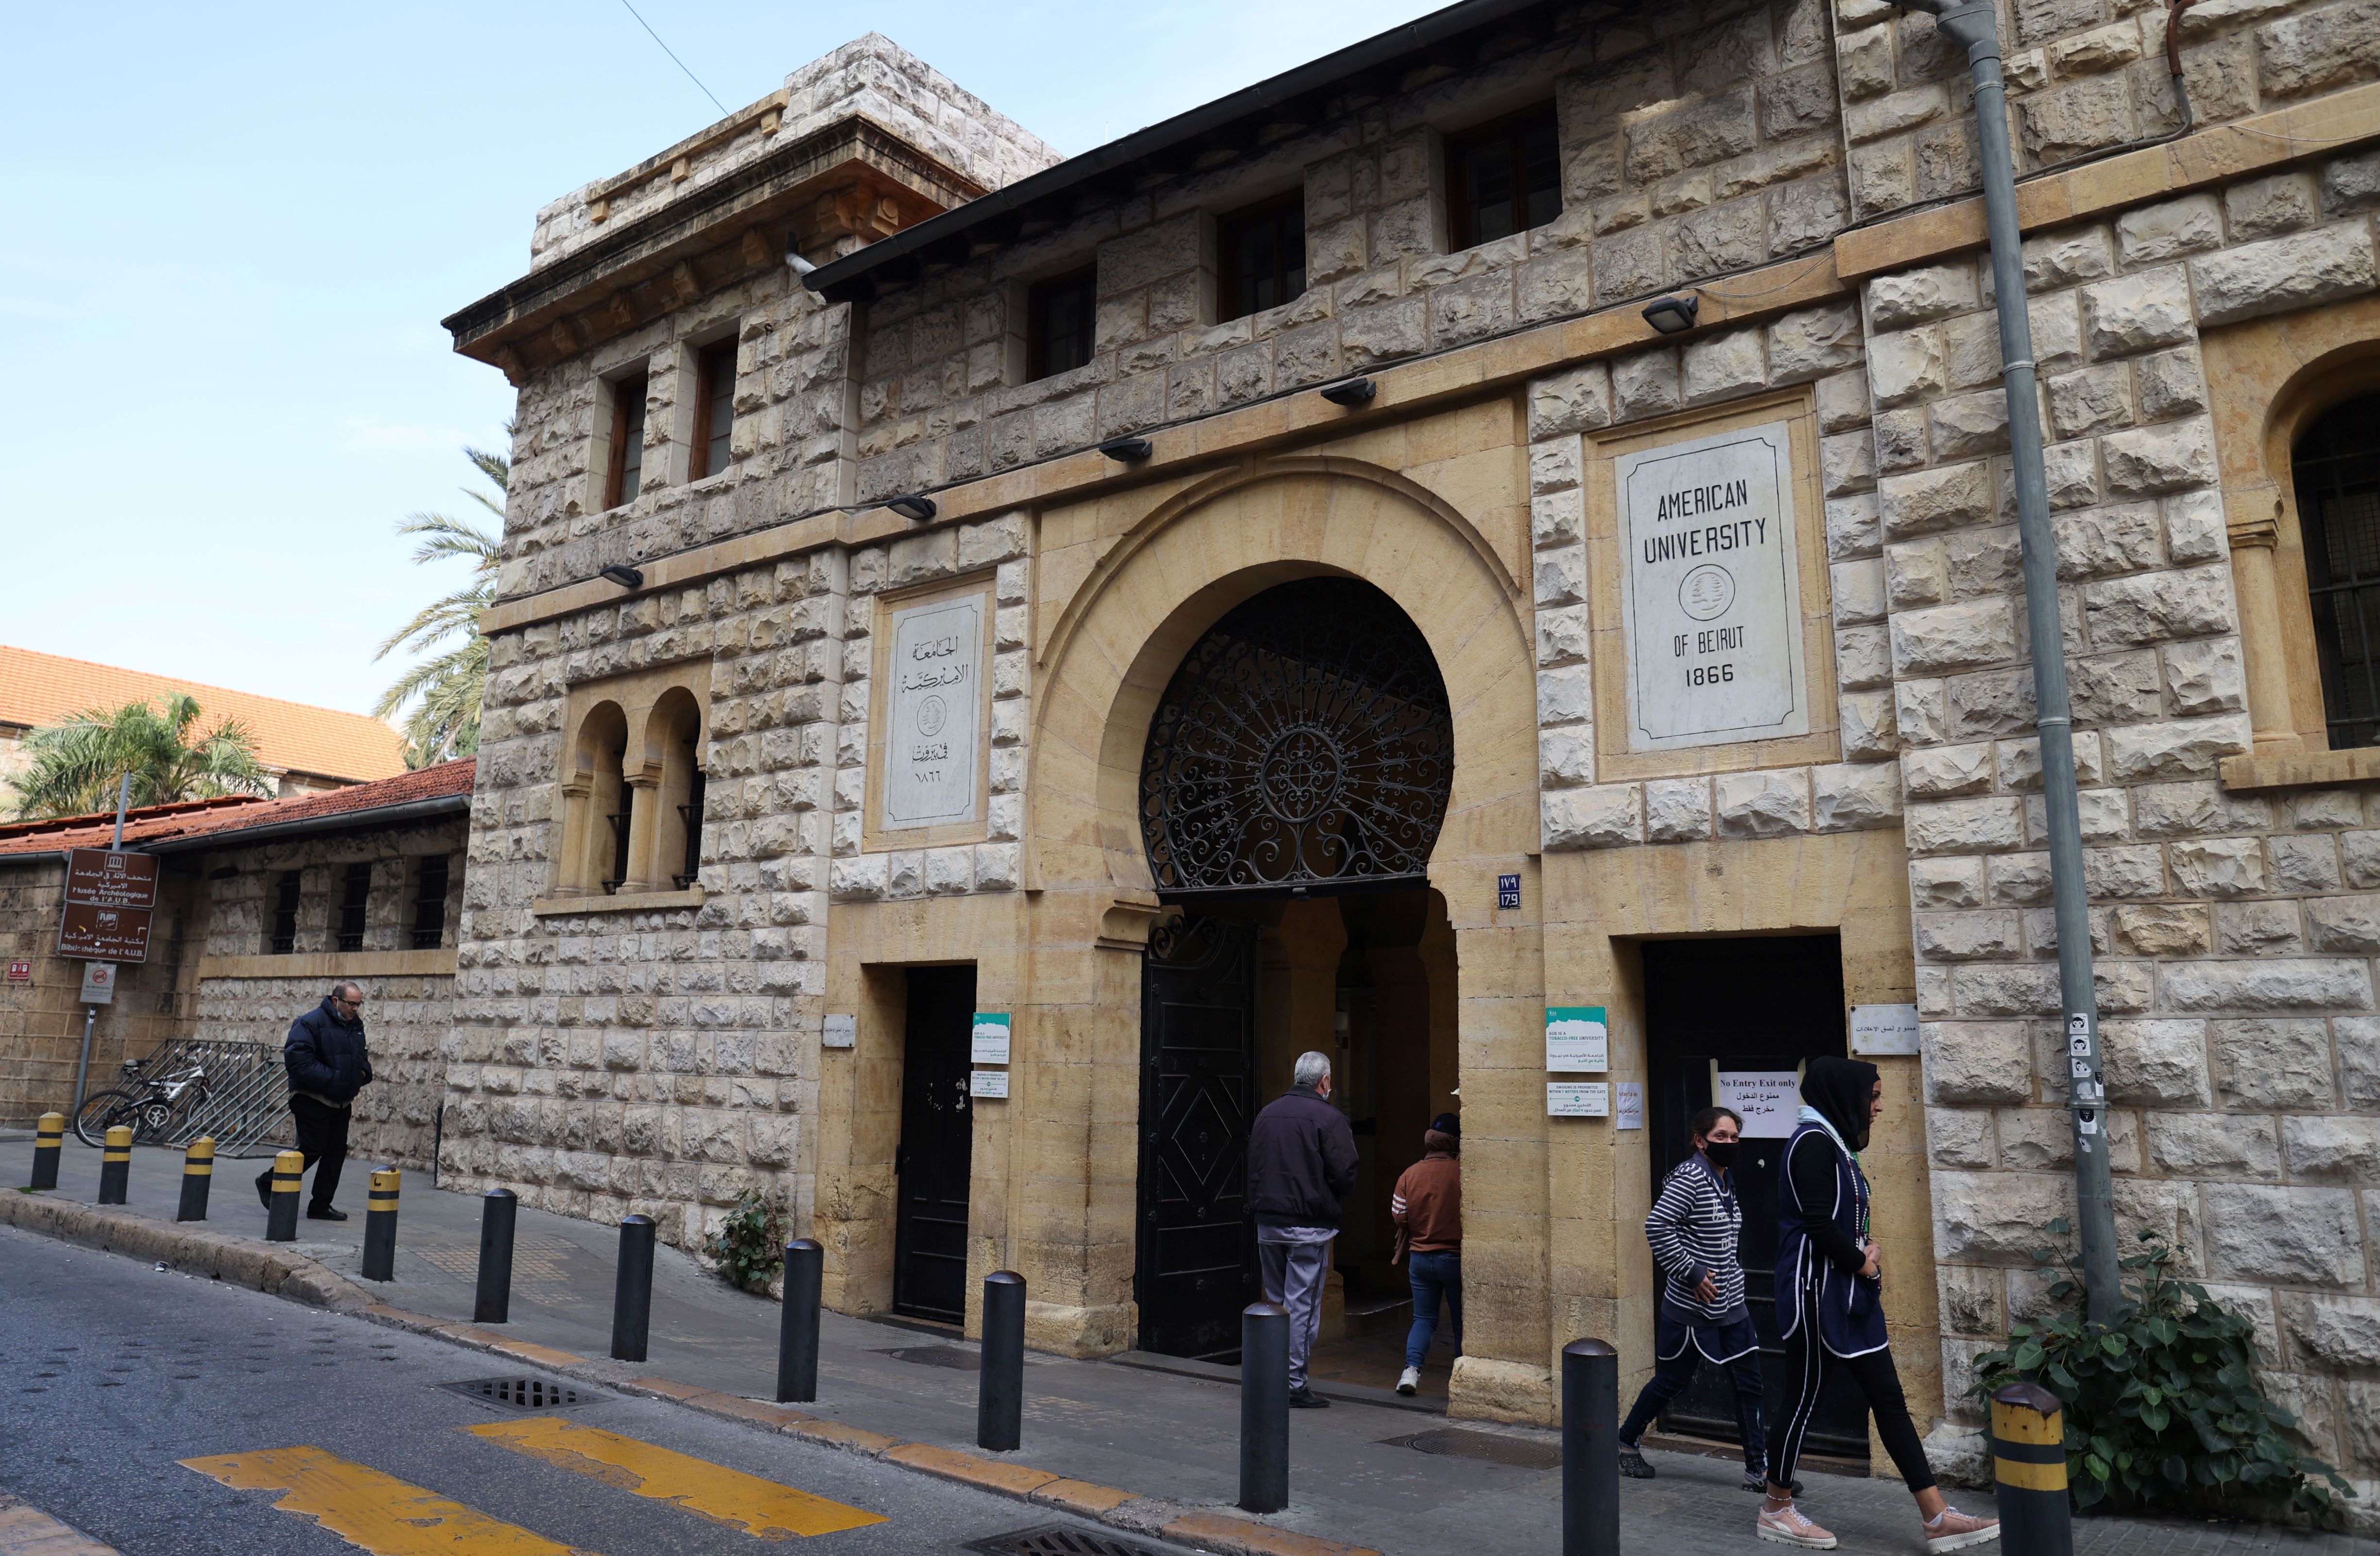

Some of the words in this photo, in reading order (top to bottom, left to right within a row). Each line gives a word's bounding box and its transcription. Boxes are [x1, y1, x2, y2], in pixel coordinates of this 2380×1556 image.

[1657, 479, 1748, 522] AMERICAN
[1644, 517, 1766, 564] UNIVERSITY
[1674, 634, 1688, 657] OF
[1698, 626, 1744, 654] BEIRUT
[1686, 664, 1734, 687] 1866
[915, 770, 940, 783] ١٨٦٦
[1500, 877, 1517, 889] ١٧٩
[99, 889, 148, 899] Archéologique
[1501, 893, 1518, 906] 179
[1733, 1079, 1756, 1089] Entry
[1778, 1079, 1796, 1088] only
[1736, 1092, 1757, 1100] الدخول
[1760, 1093, 1779, 1101] ممنوع
[1756, 1106, 1774, 1114] مخرج
